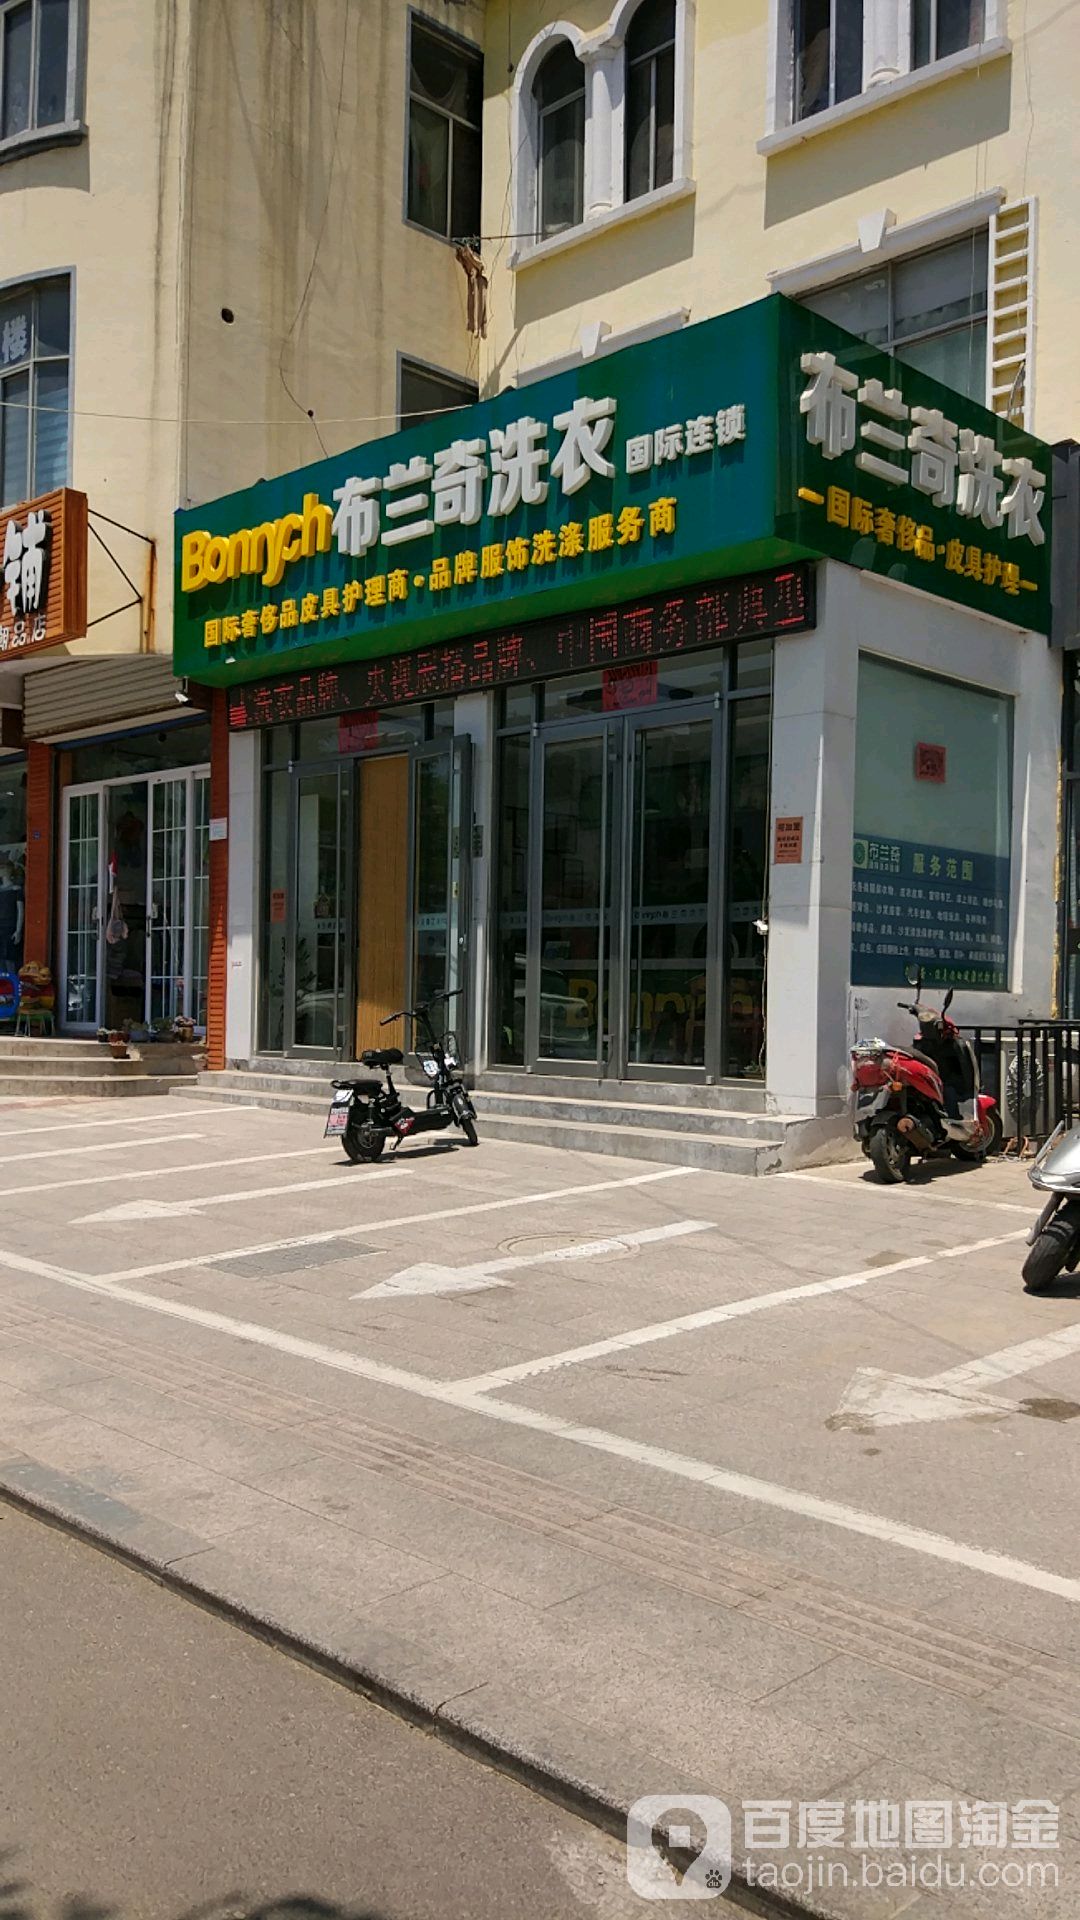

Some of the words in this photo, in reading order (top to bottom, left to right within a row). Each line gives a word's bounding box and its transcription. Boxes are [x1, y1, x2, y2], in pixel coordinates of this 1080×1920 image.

[181, 492, 334, 593] Bonnych
[333, 396, 616, 557] 布兰奇洗衣
[625, 404, 747, 474] 国际连锁
[799, 351, 1046, 546] 布兰奇洗衣
[869, 843, 901, 863] 布兰奇
[912, 852, 974, 882] 服务范围
